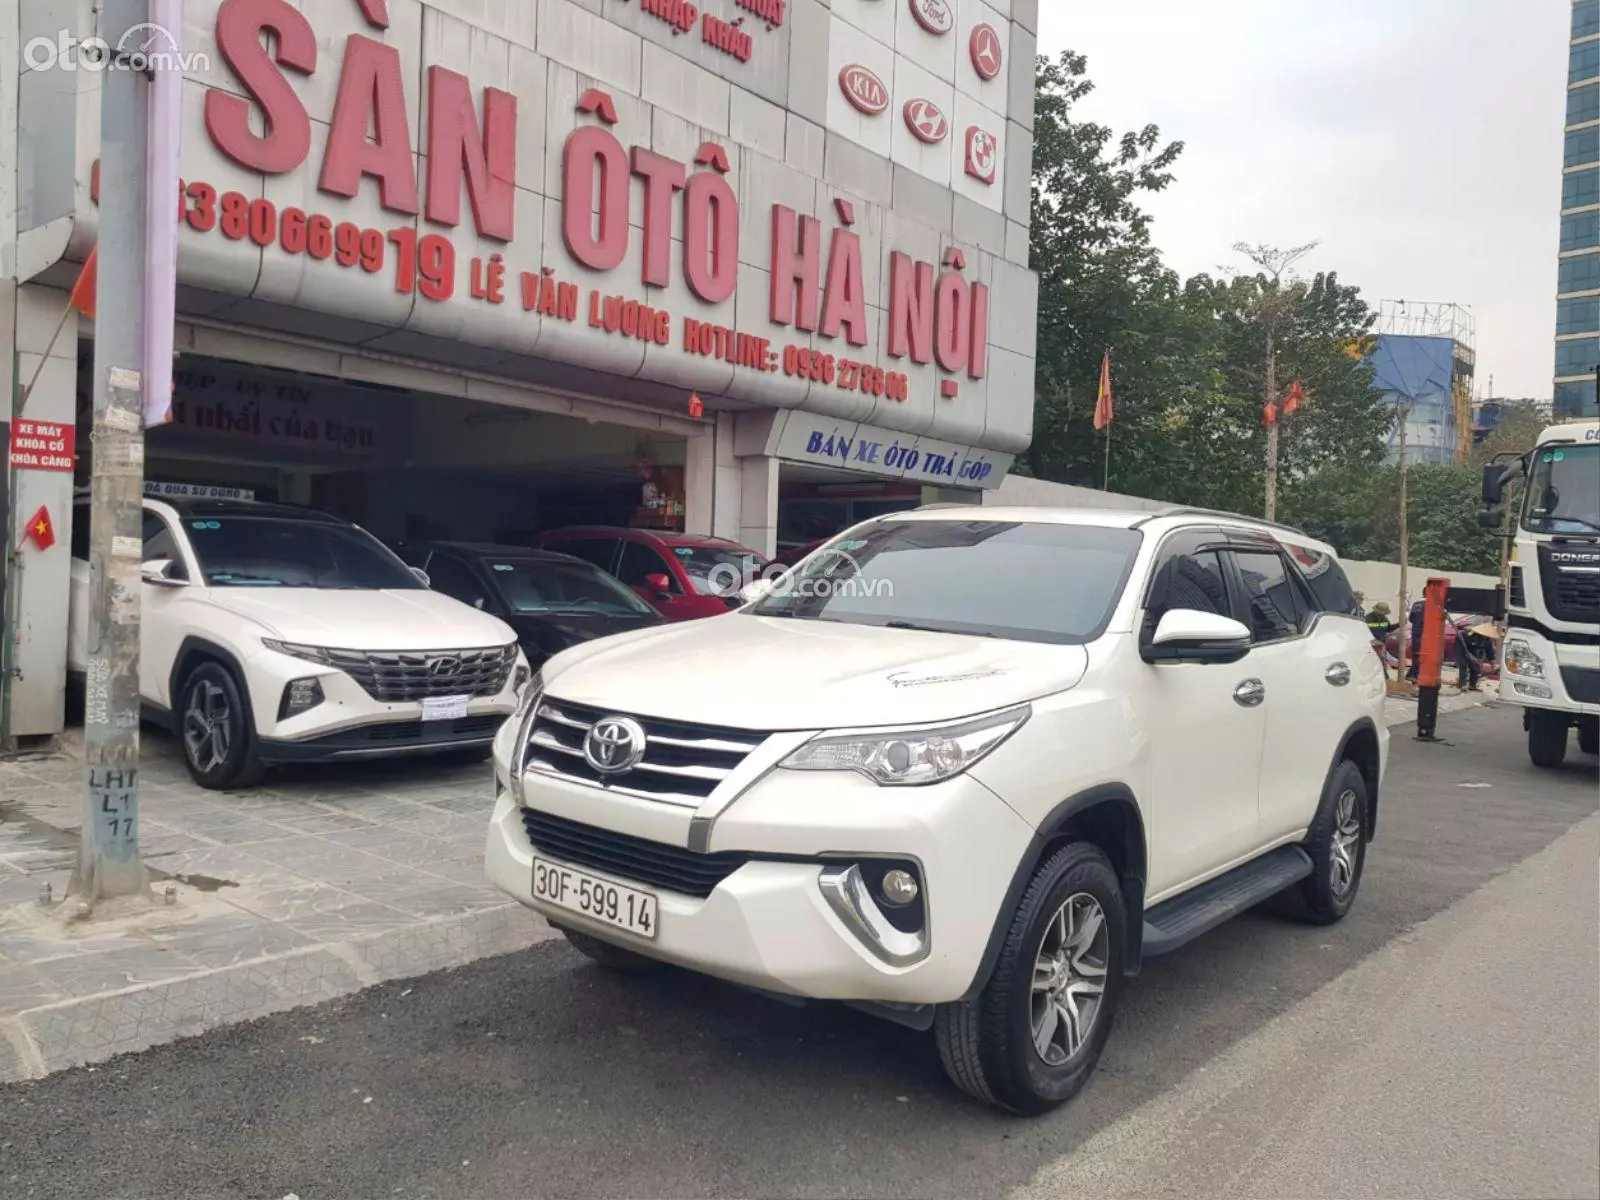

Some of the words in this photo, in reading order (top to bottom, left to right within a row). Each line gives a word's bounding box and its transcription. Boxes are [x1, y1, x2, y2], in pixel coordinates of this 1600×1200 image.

[853, 73, 882, 105] KIA
[204, 0, 518, 243] SÀN
[563, 88, 739, 303] ÔTÔ
[769, 198, 868, 347] HÀ
[888, 246, 988, 398] NỘI
[178, 177, 384, 273] 3806699
[470, 253, 506, 304] LÊ
[520, 267, 579, 322] VĂN
[588, 289, 671, 345] LƯƠNG
[684, 317, 779, 372] HOTLINE:
[19, 424, 34, 435] XE
[806, 427, 852, 462] BÁN
[852, 439, 884, 464] XE
[922, 451, 958, 477] TRẢ
[959, 454, 993, 481] GÓP
[536, 863, 651, 932] 30F-599.14
